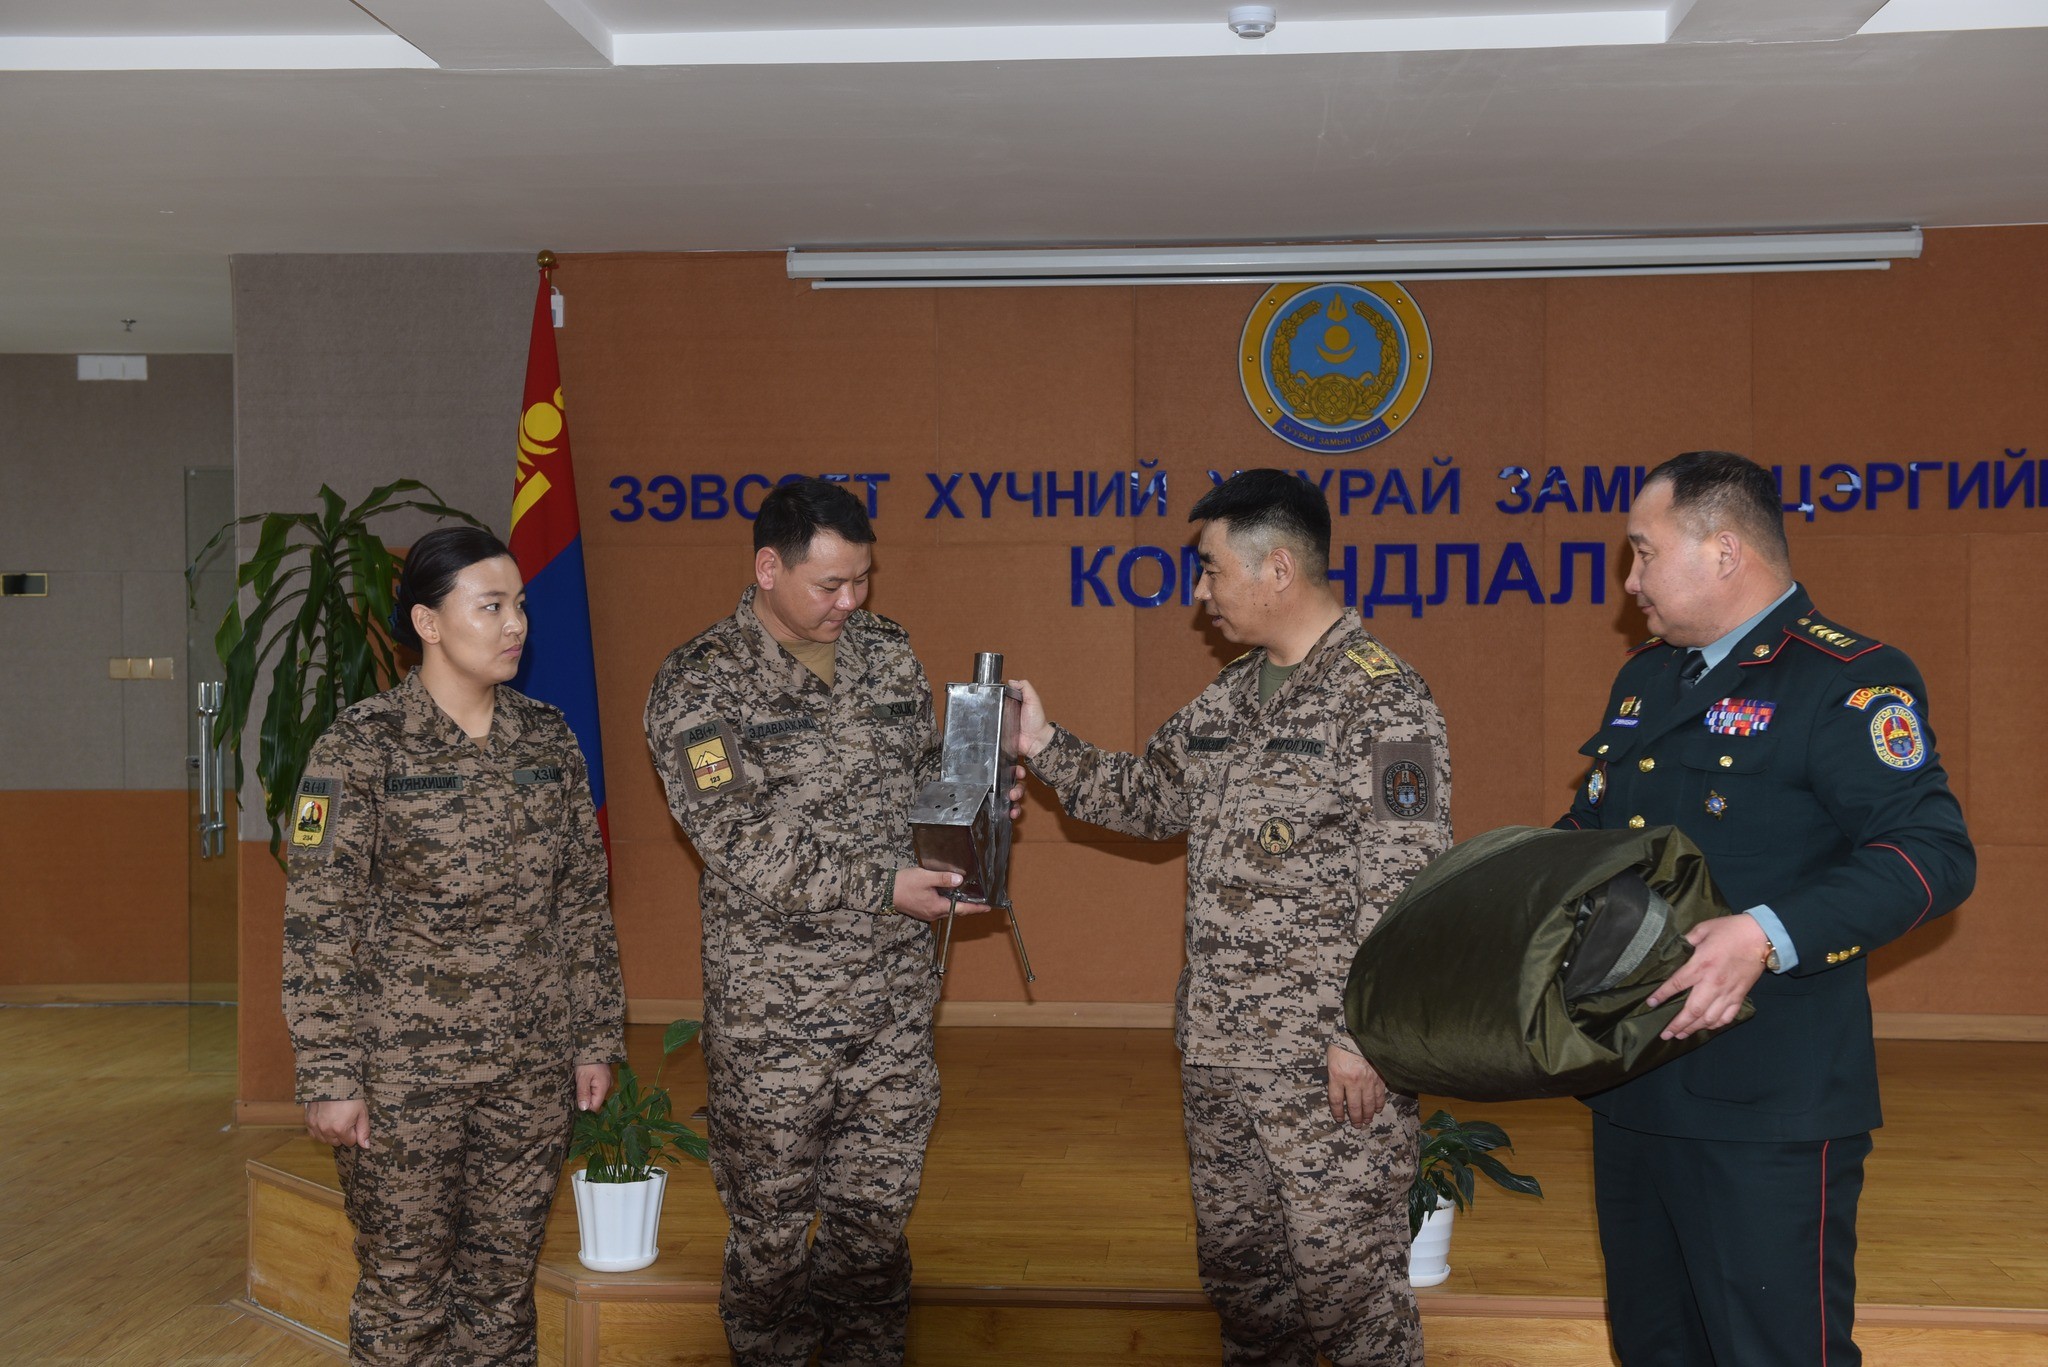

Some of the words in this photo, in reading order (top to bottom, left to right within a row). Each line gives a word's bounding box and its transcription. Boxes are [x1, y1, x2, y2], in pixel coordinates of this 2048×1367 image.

[1318, 437, 1351, 446] ЗАМЫН
[1355, 425, 1382, 443] ЦЭРЭГ
[609, 473, 890, 523] ЗЭВСТ
[925, 458, 1167, 519] ХҮЧНИЙ
[1496, 465, 1646, 515] ЗАМ
[1850, 686, 1912, 708] MONGOLIA
[1300, 741, 1322, 755] УЛС
[709, 775, 721, 784] 123
